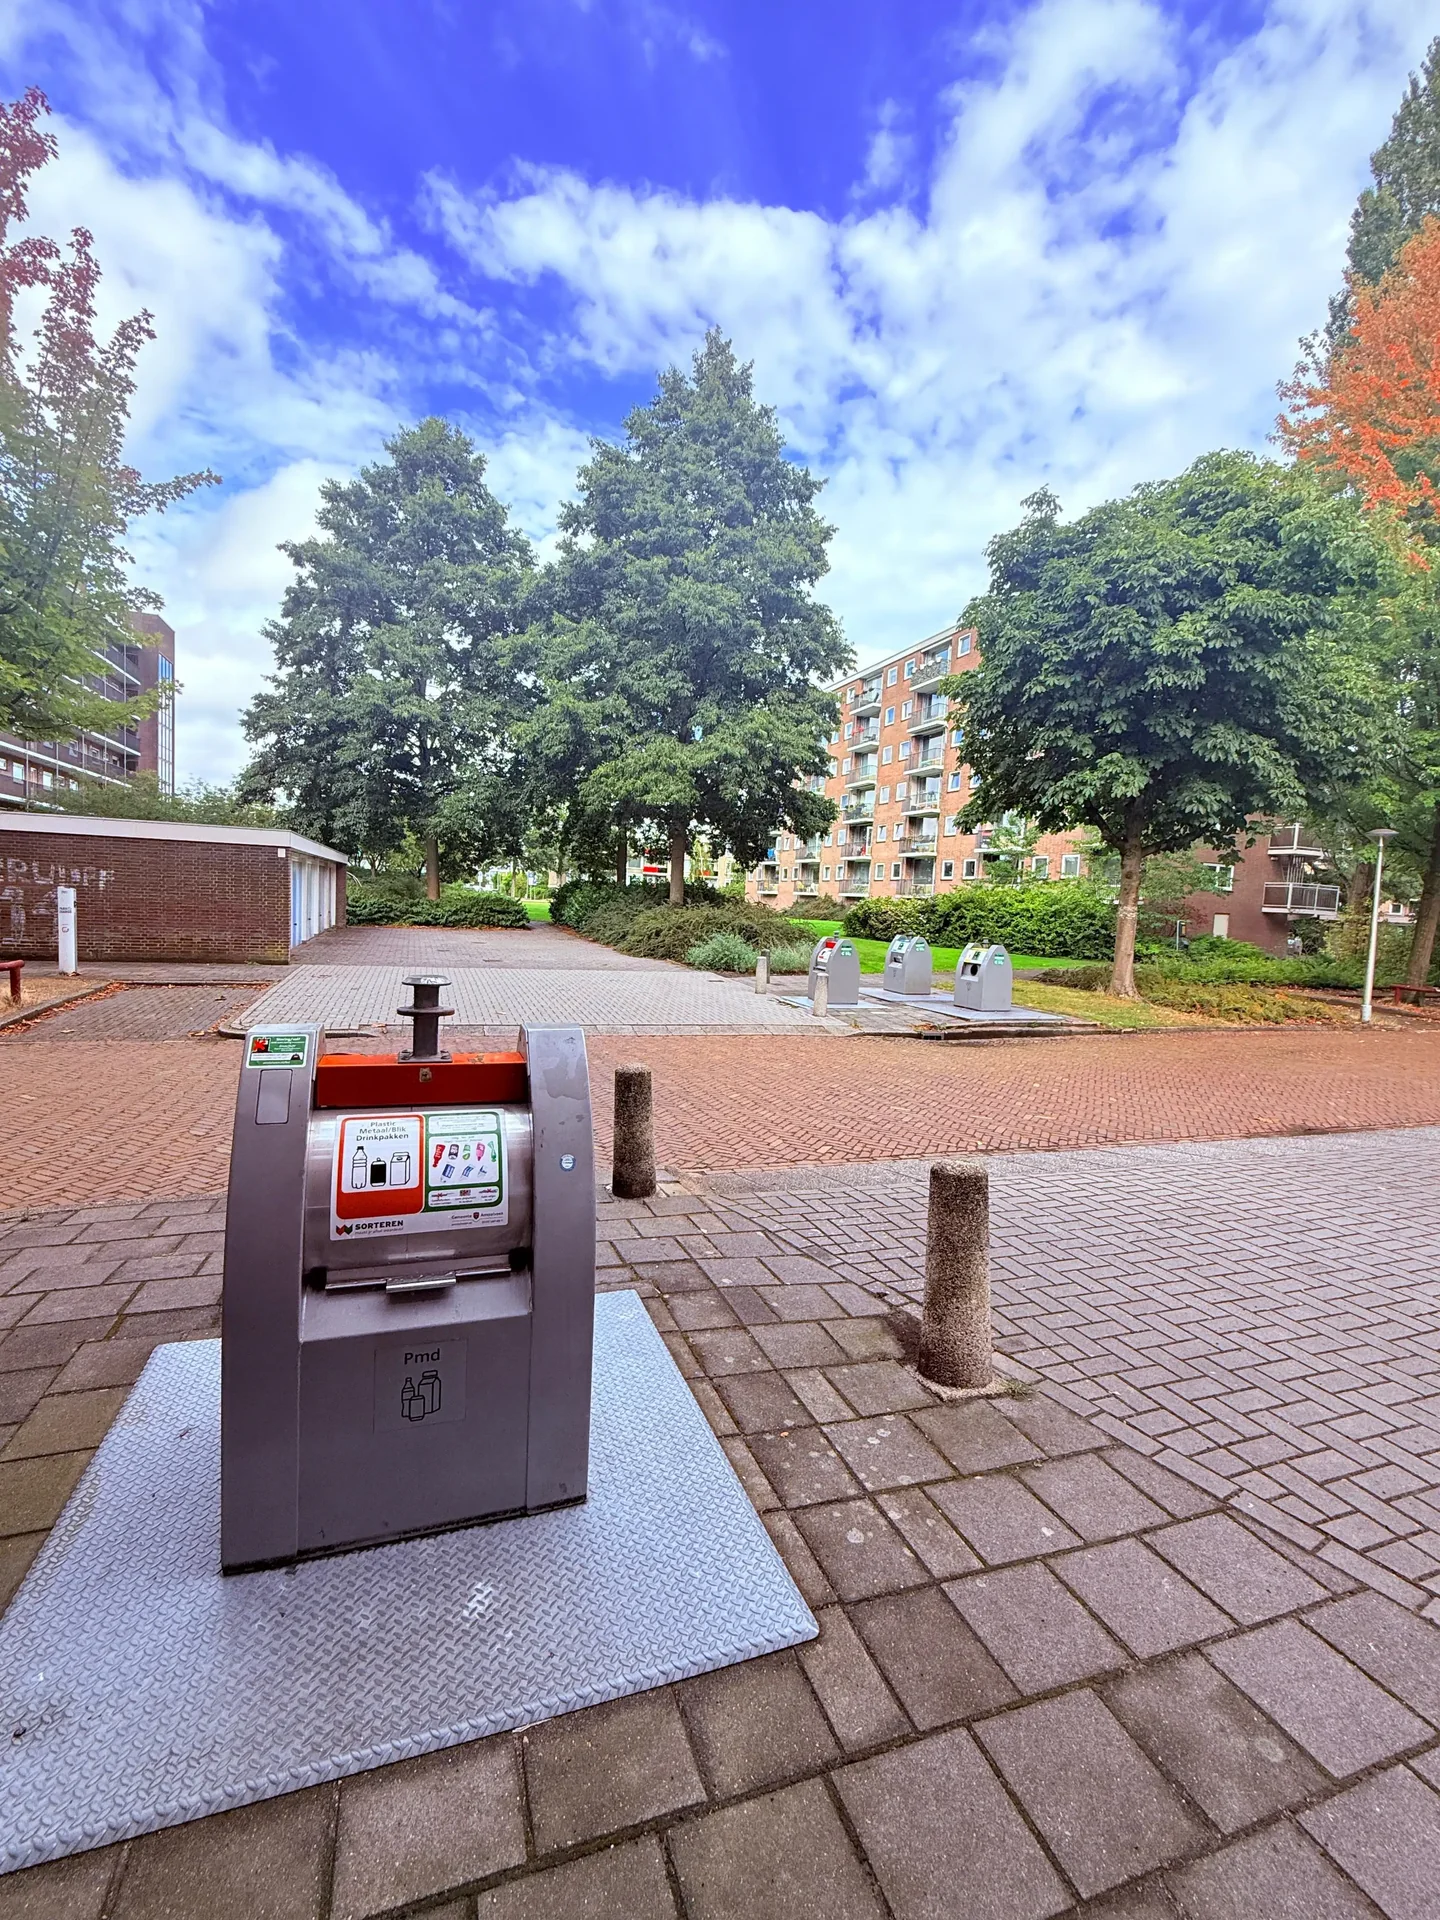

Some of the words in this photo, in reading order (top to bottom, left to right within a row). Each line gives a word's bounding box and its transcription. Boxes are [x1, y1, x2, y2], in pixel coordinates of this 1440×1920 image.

[359, 1126, 406, 1134] Metaal/Blik
[356, 1133, 409, 1142] Drinkpakken
[355, 1220, 404, 1231] SORTEREN
[404, 1347, 440, 1365] Pmd
